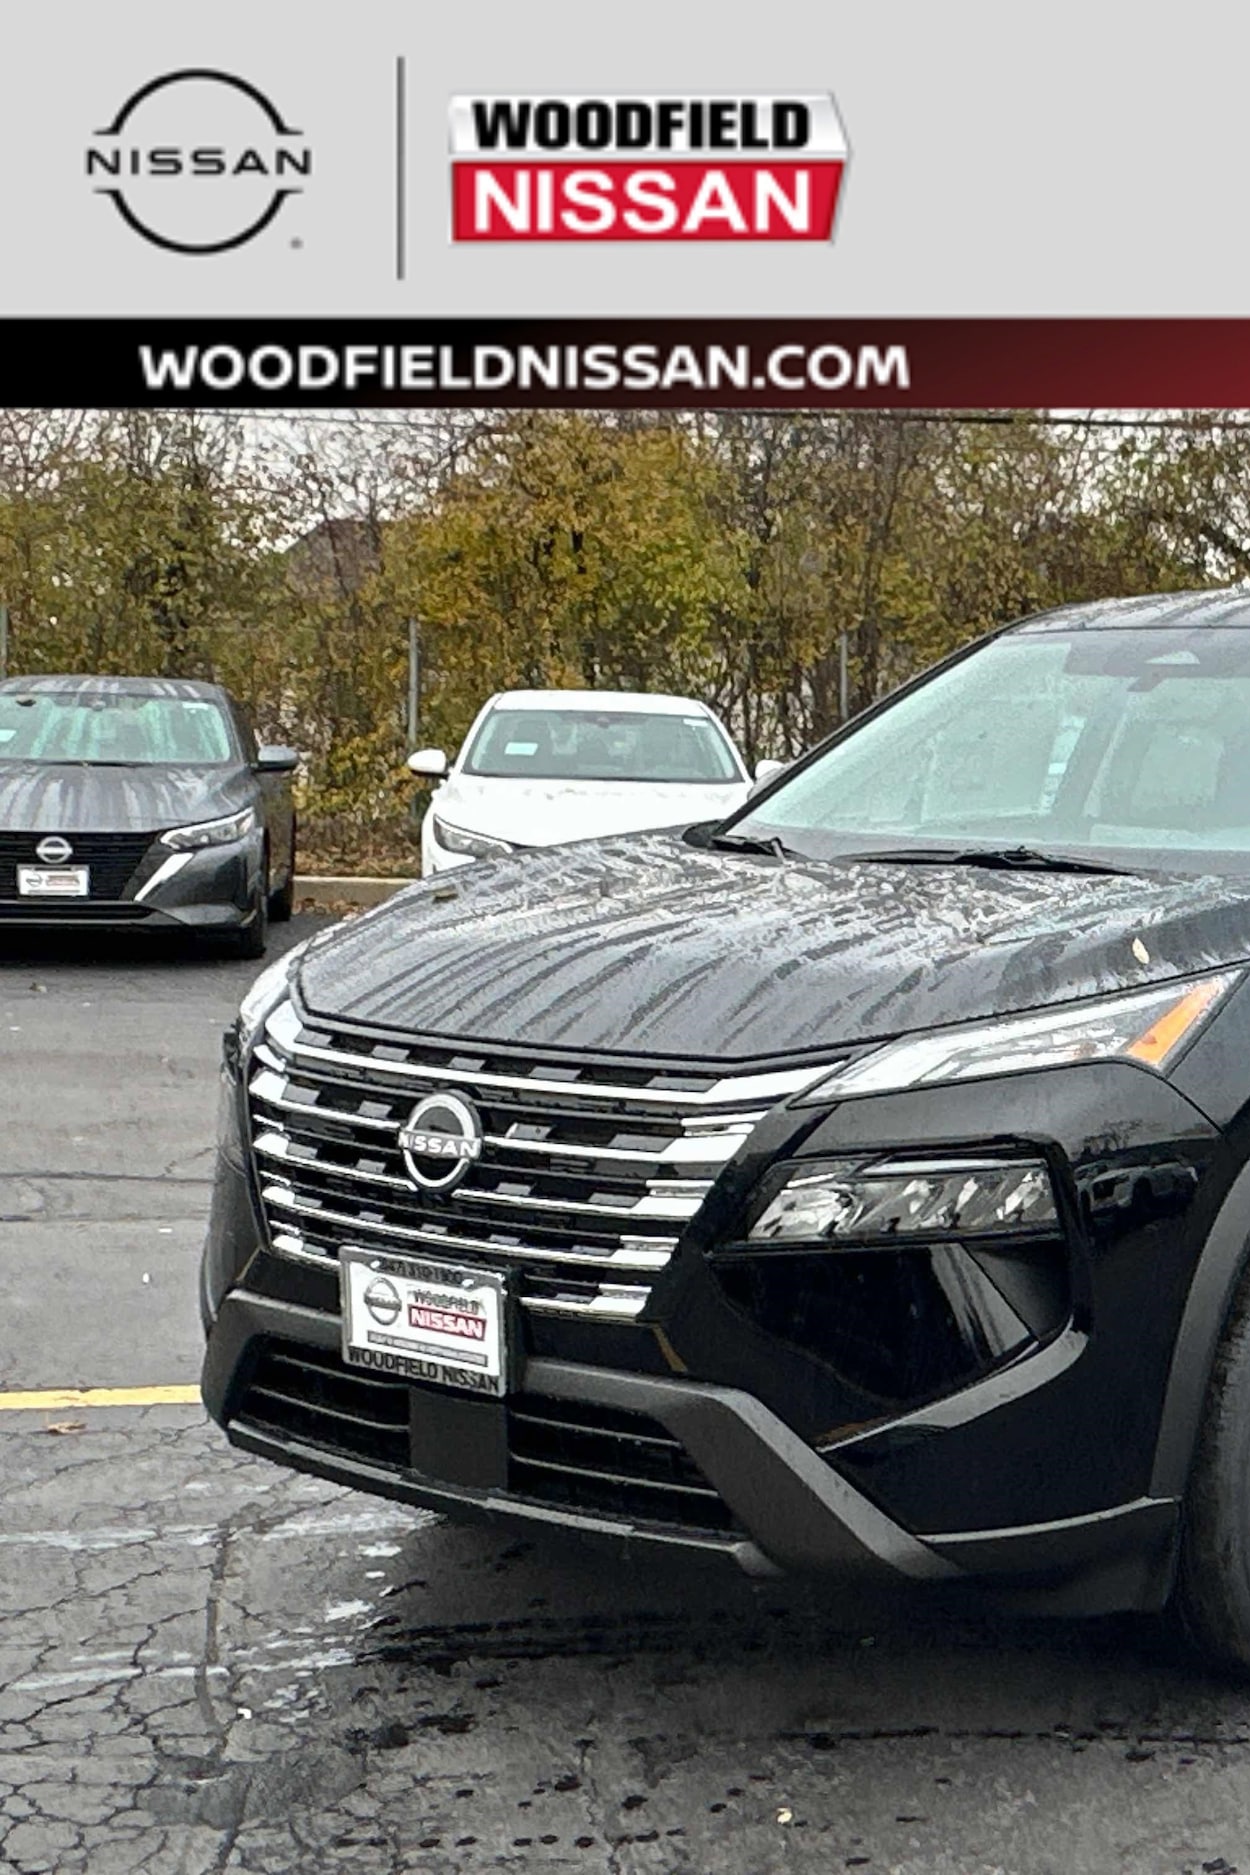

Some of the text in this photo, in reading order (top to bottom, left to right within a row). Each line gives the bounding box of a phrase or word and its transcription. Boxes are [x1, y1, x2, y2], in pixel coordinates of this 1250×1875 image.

[399, 1131, 478, 1157] NISSAN
[410, 1309, 484, 1338] NISSAN
[349, 1347, 438, 1380] WOODFIELD
[441, 1362, 499, 1394] NISSAN
